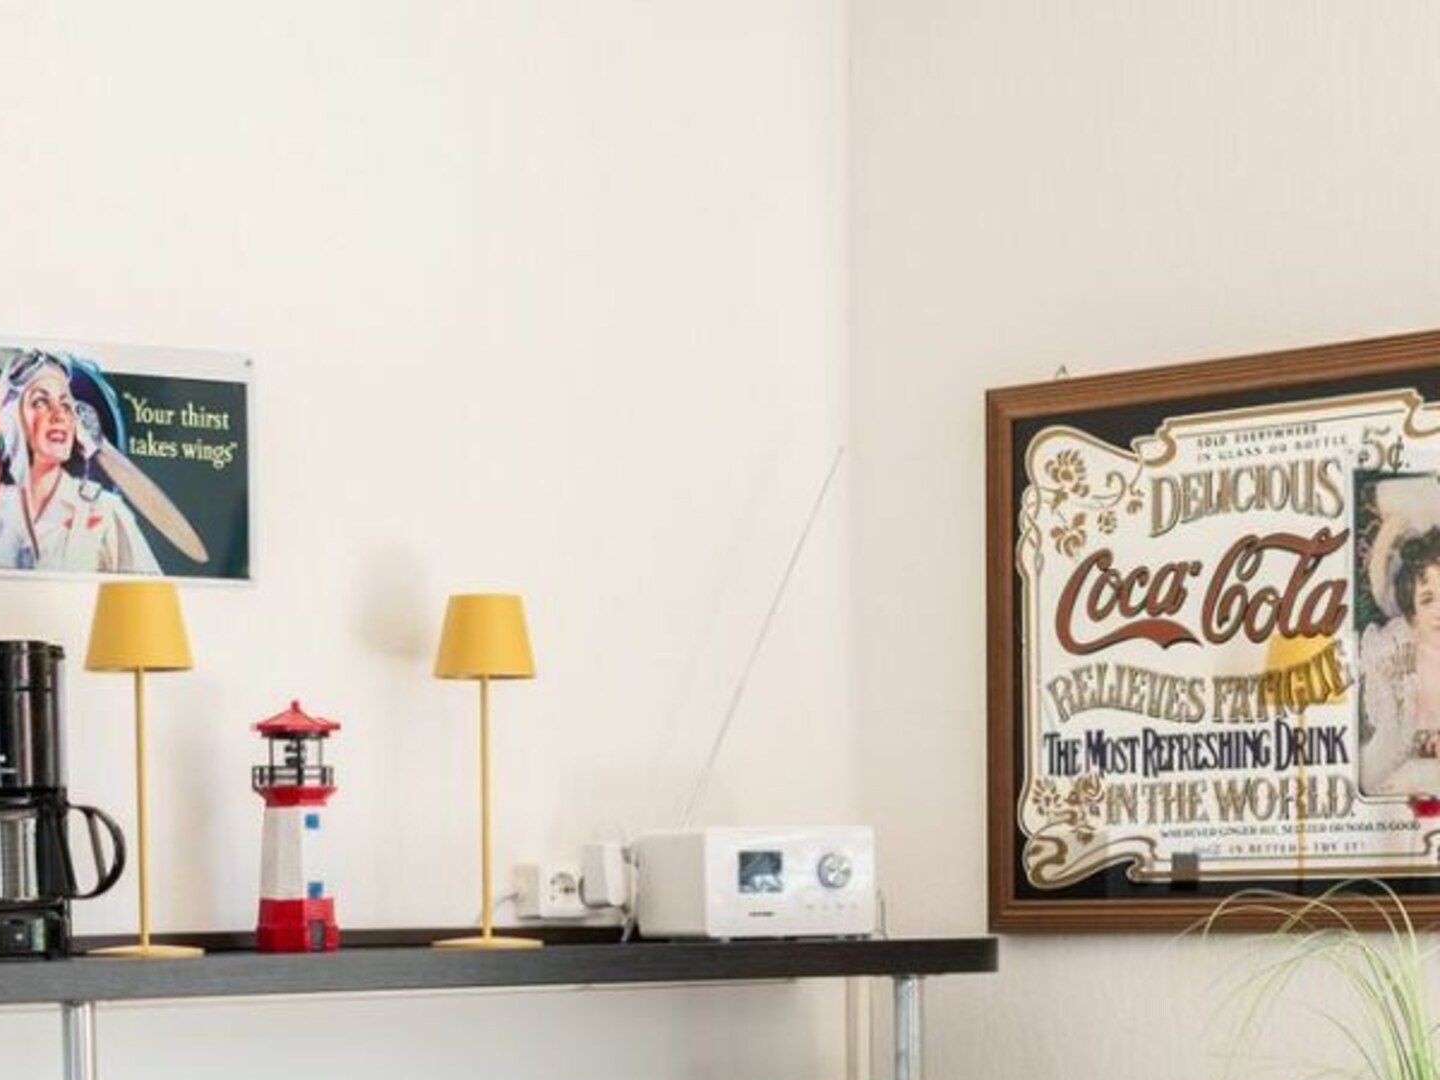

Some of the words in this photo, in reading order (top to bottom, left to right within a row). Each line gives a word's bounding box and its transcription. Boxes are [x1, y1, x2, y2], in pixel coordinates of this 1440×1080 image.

[181, 401, 230, 431] thirst
[129, 430, 178, 459] takes
[1149, 458, 1347, 538] DELICIOUS
[1046, 661, 1207, 723] RELIEVES
[1212, 638, 1354, 723] FATIGUE
[1044, 731, 1082, 777] THE
[1084, 729, 1140, 778] MOST
[1142, 726, 1272, 778] REFRESHING
[1273, 718, 1350, 772] DRINK
[1105, 781, 1139, 825] IN
[1141, 778, 1211, 825] THE
